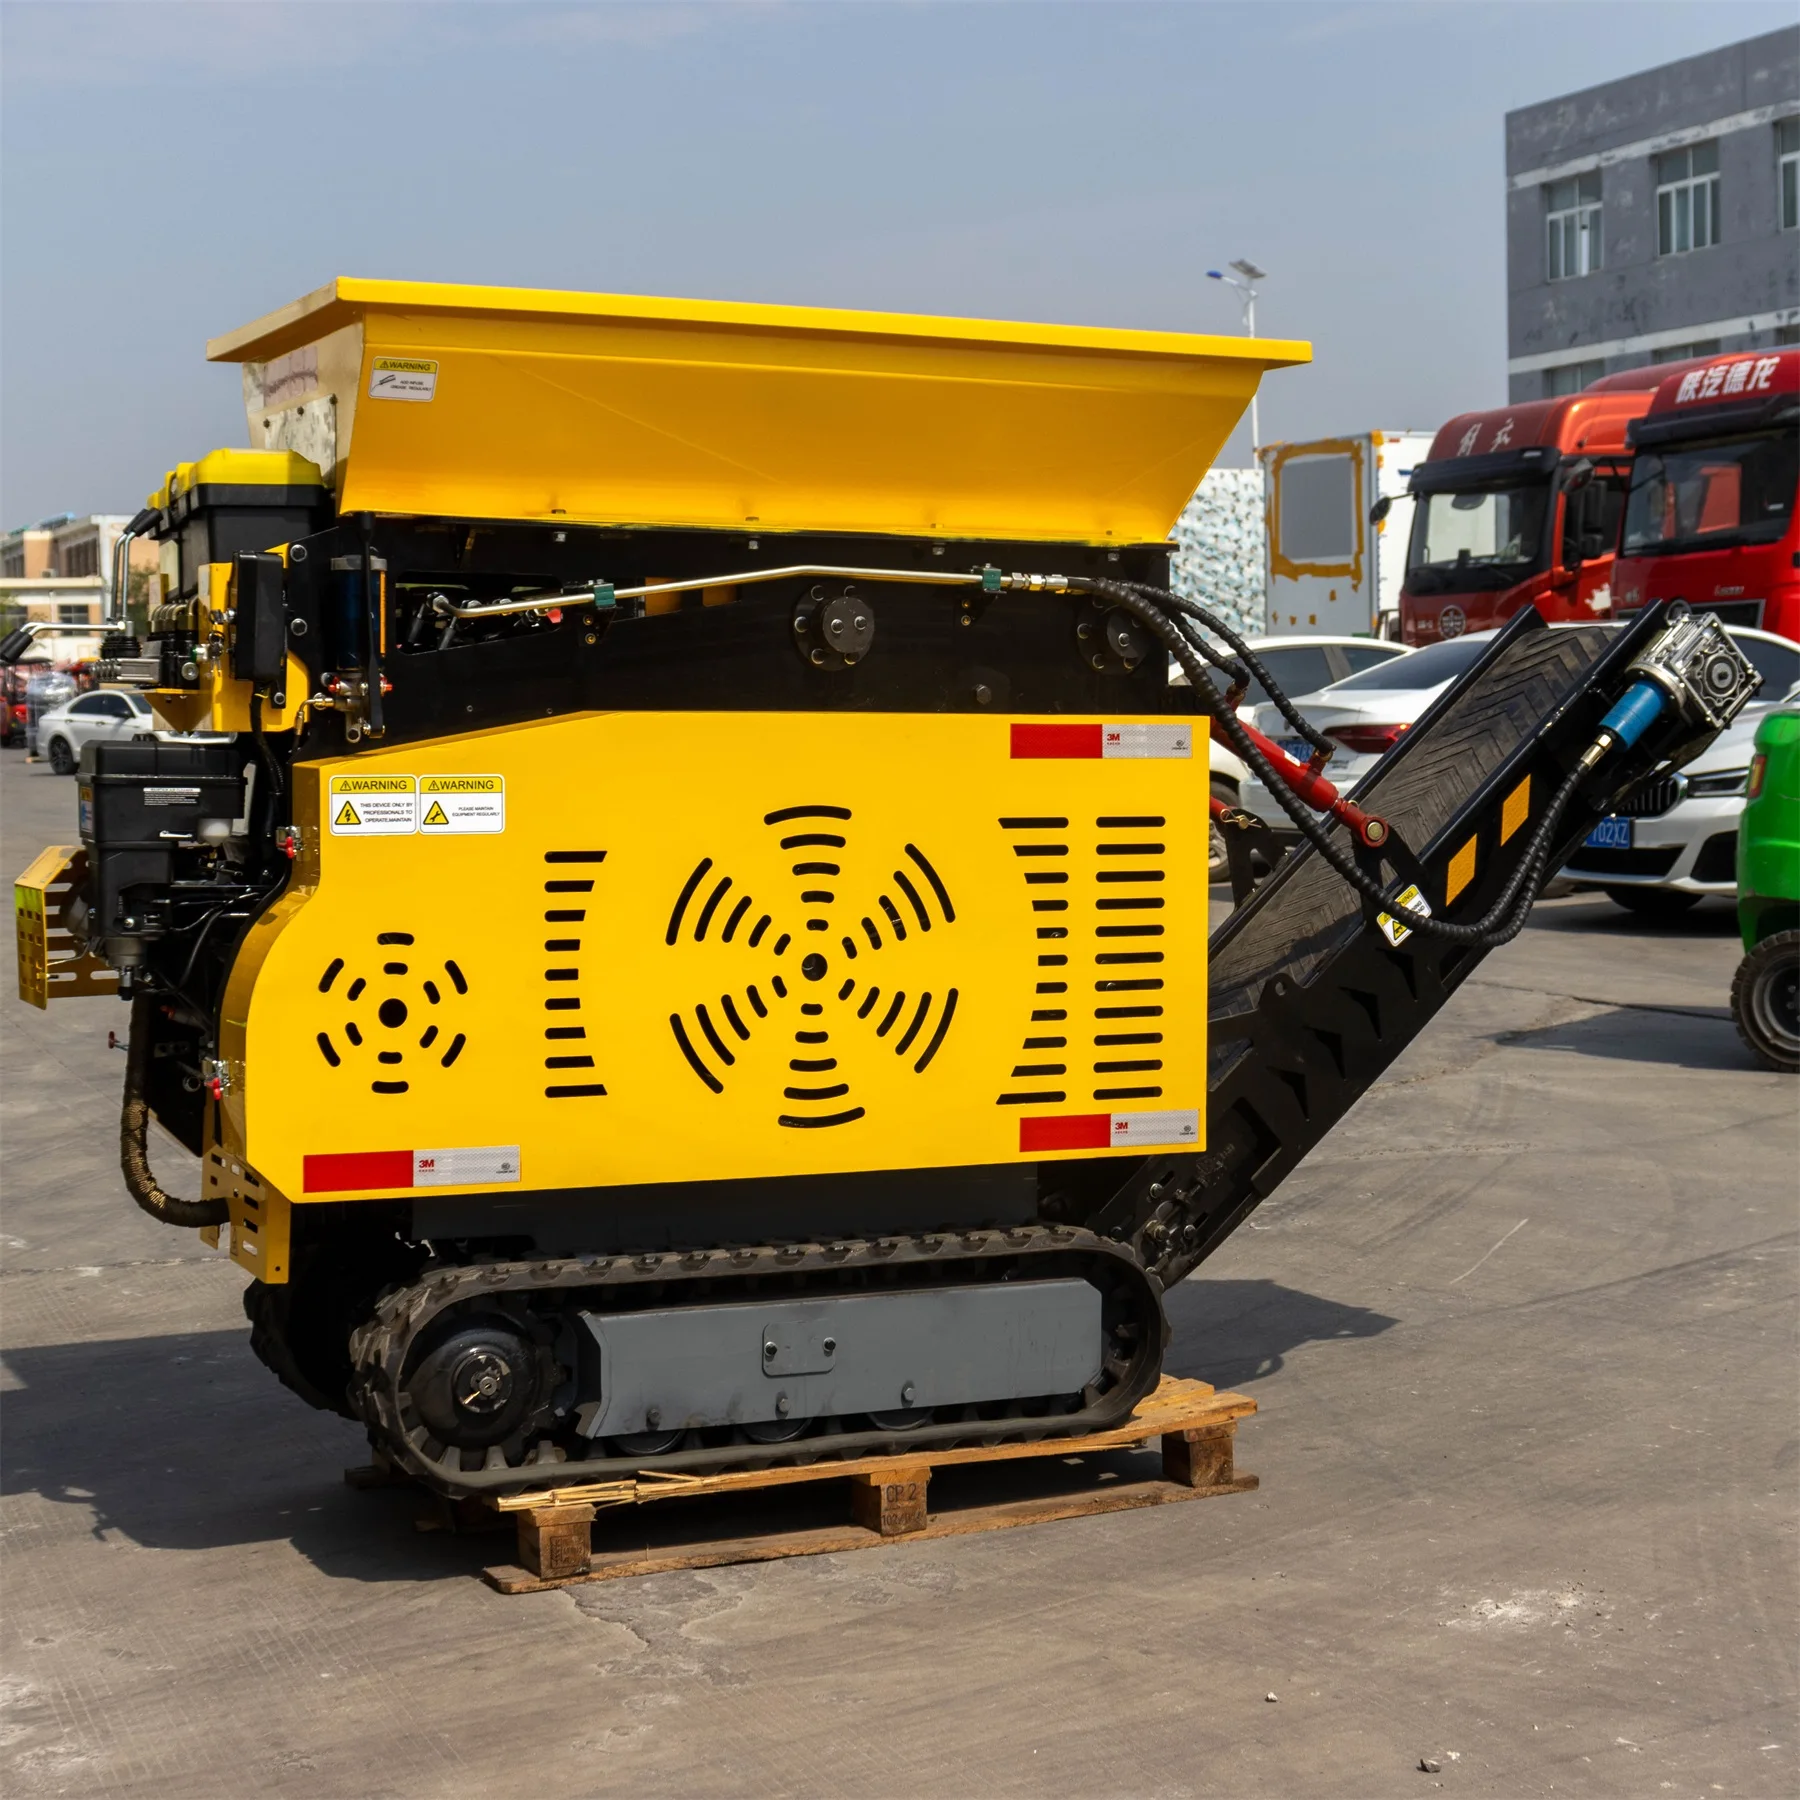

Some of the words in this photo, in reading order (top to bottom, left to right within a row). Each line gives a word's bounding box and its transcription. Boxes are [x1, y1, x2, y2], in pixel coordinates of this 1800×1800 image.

[390, 361, 430, 370] WARNING
[1106, 733, 1120, 741] 3M
[352, 780, 407, 790] WARNING
[440, 780, 494, 790] WARNING
[1114, 1121, 1128, 1131] 3M
[418, 1159, 435, 1168] 3M
[908, 1483, 917, 1500] 2
